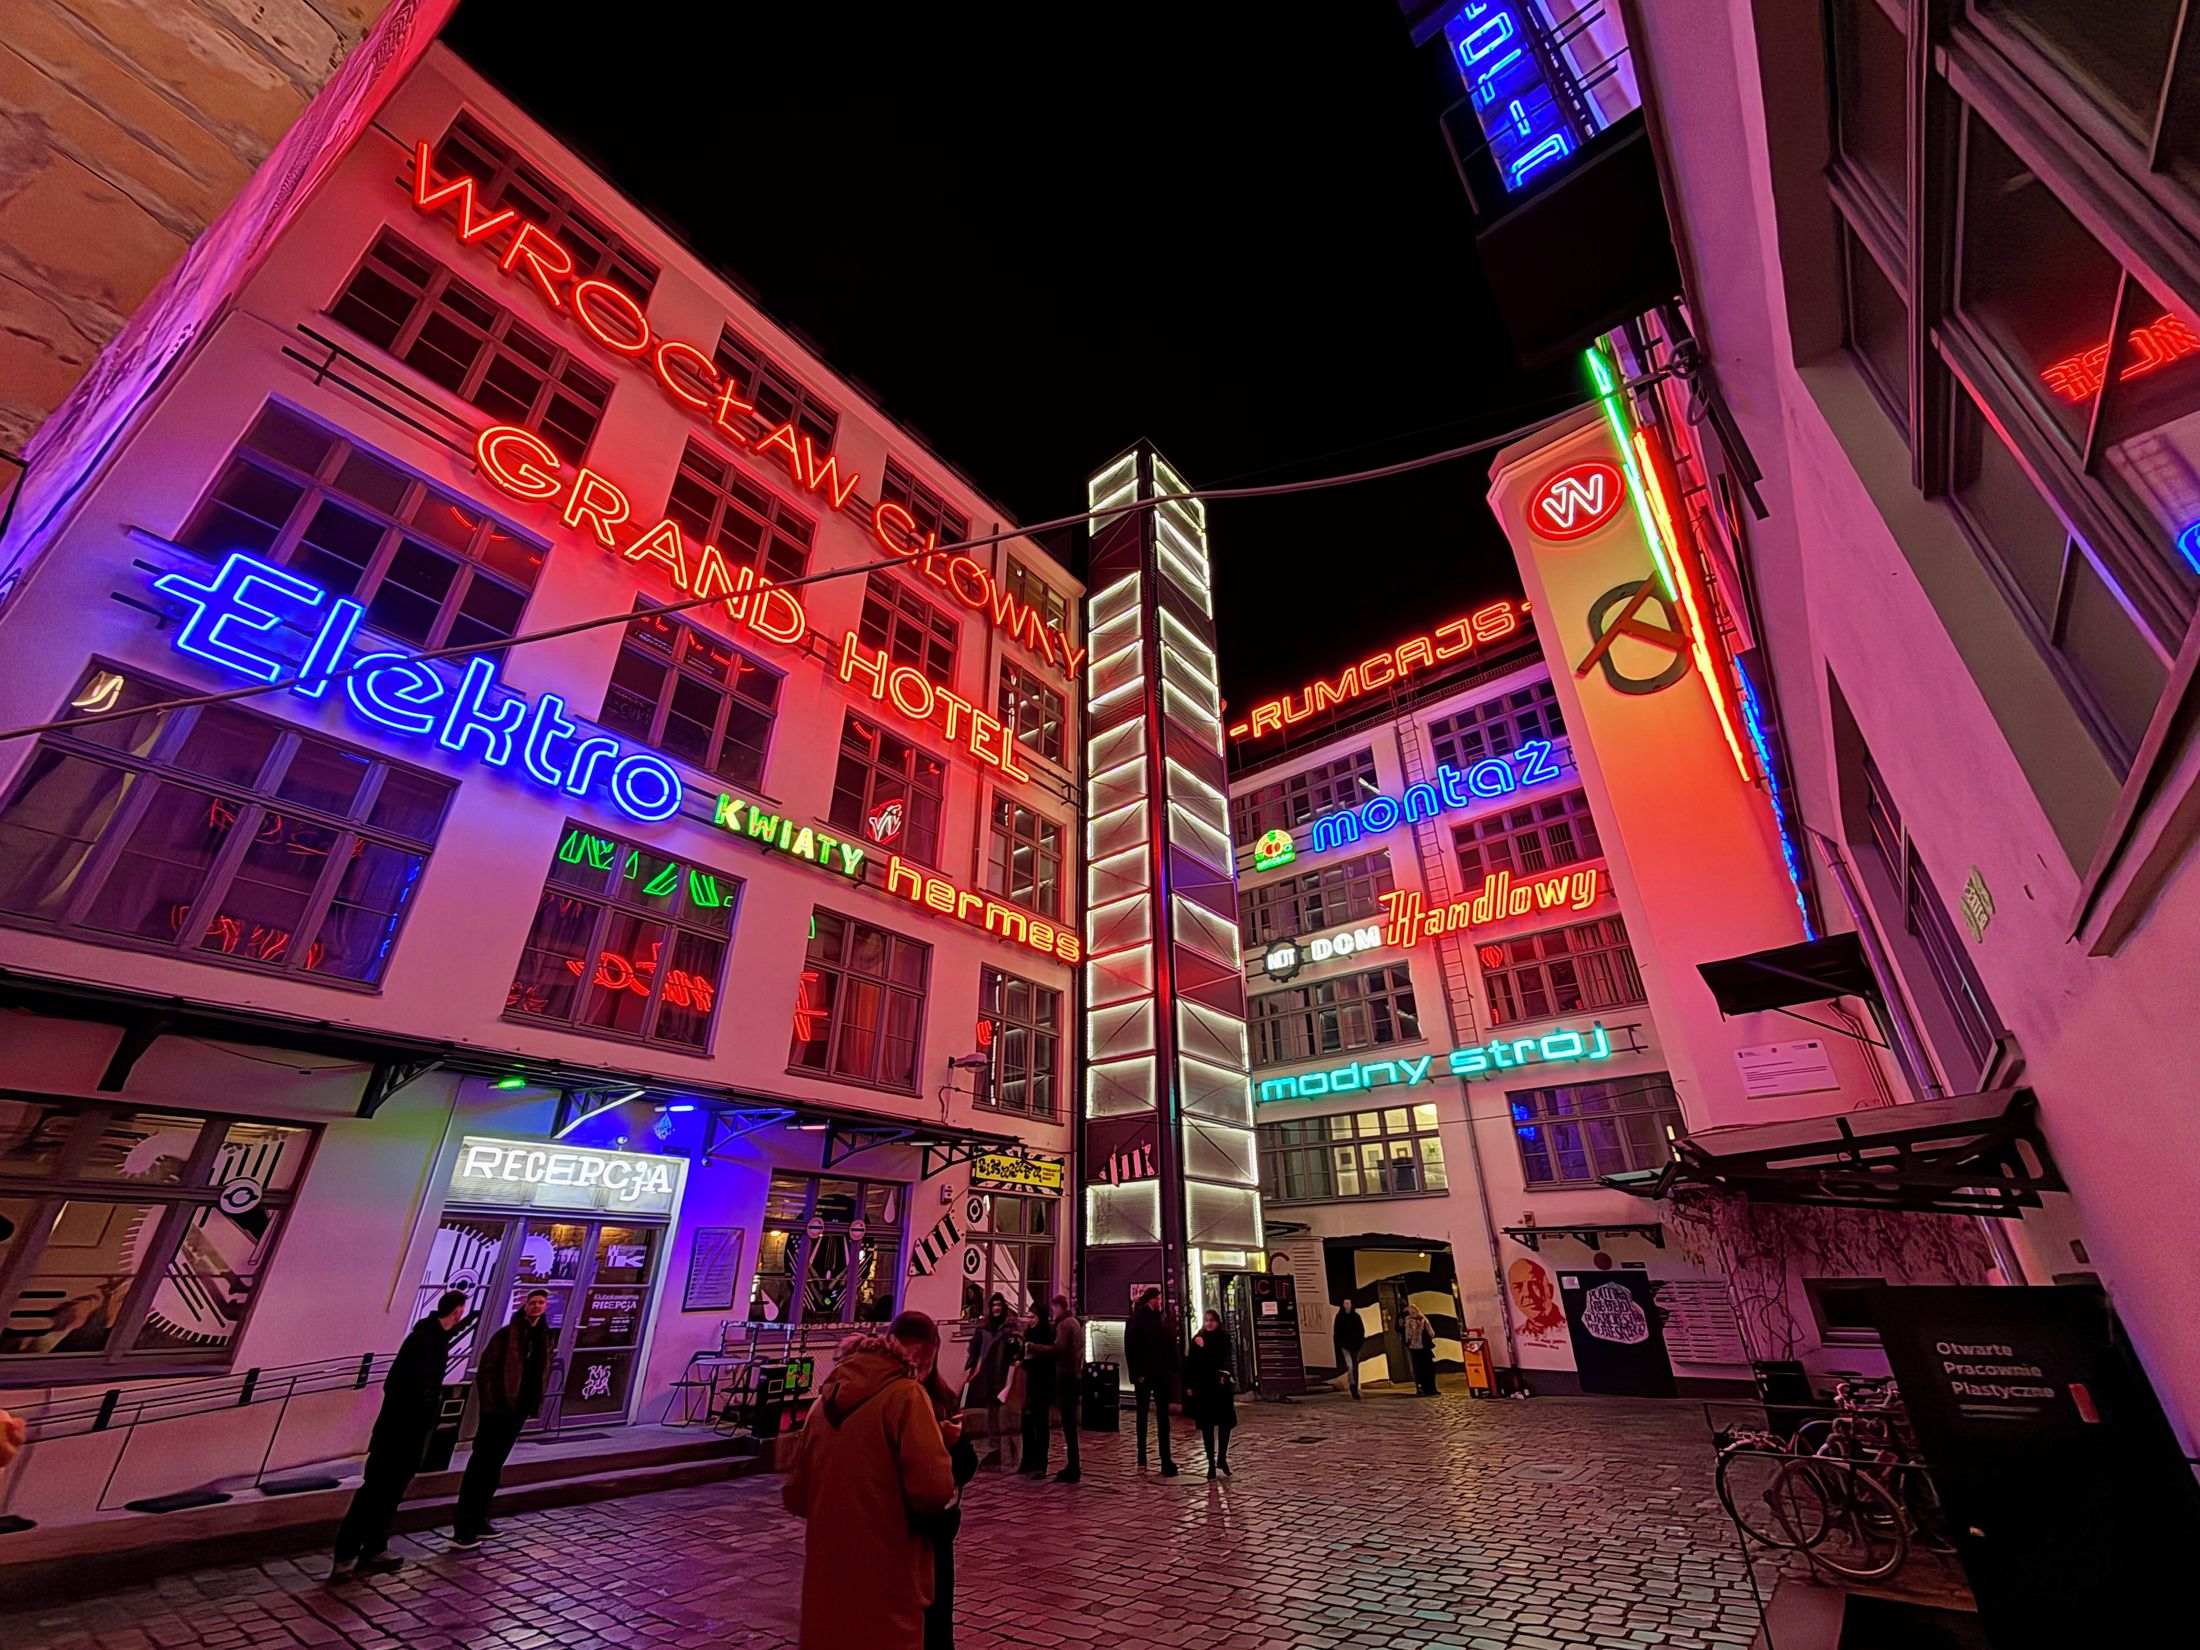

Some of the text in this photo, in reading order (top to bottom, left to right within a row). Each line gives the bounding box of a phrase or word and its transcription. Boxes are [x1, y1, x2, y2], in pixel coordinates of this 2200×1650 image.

[475, 424, 1030, 783] GRAND HOTEL
[152, 551, 684, 822] Elektro
[714, 793, 864, 875] KWIATY
[888, 856, 1080, 963] hermes
[1310, 870, 1597, 961] DOM Handlowy
[1261, 1055, 1432, 1100] modny
[1936, 1342, 2013, 1356] Otwarte
[1951, 1381, 2055, 1399] Plastyczne
